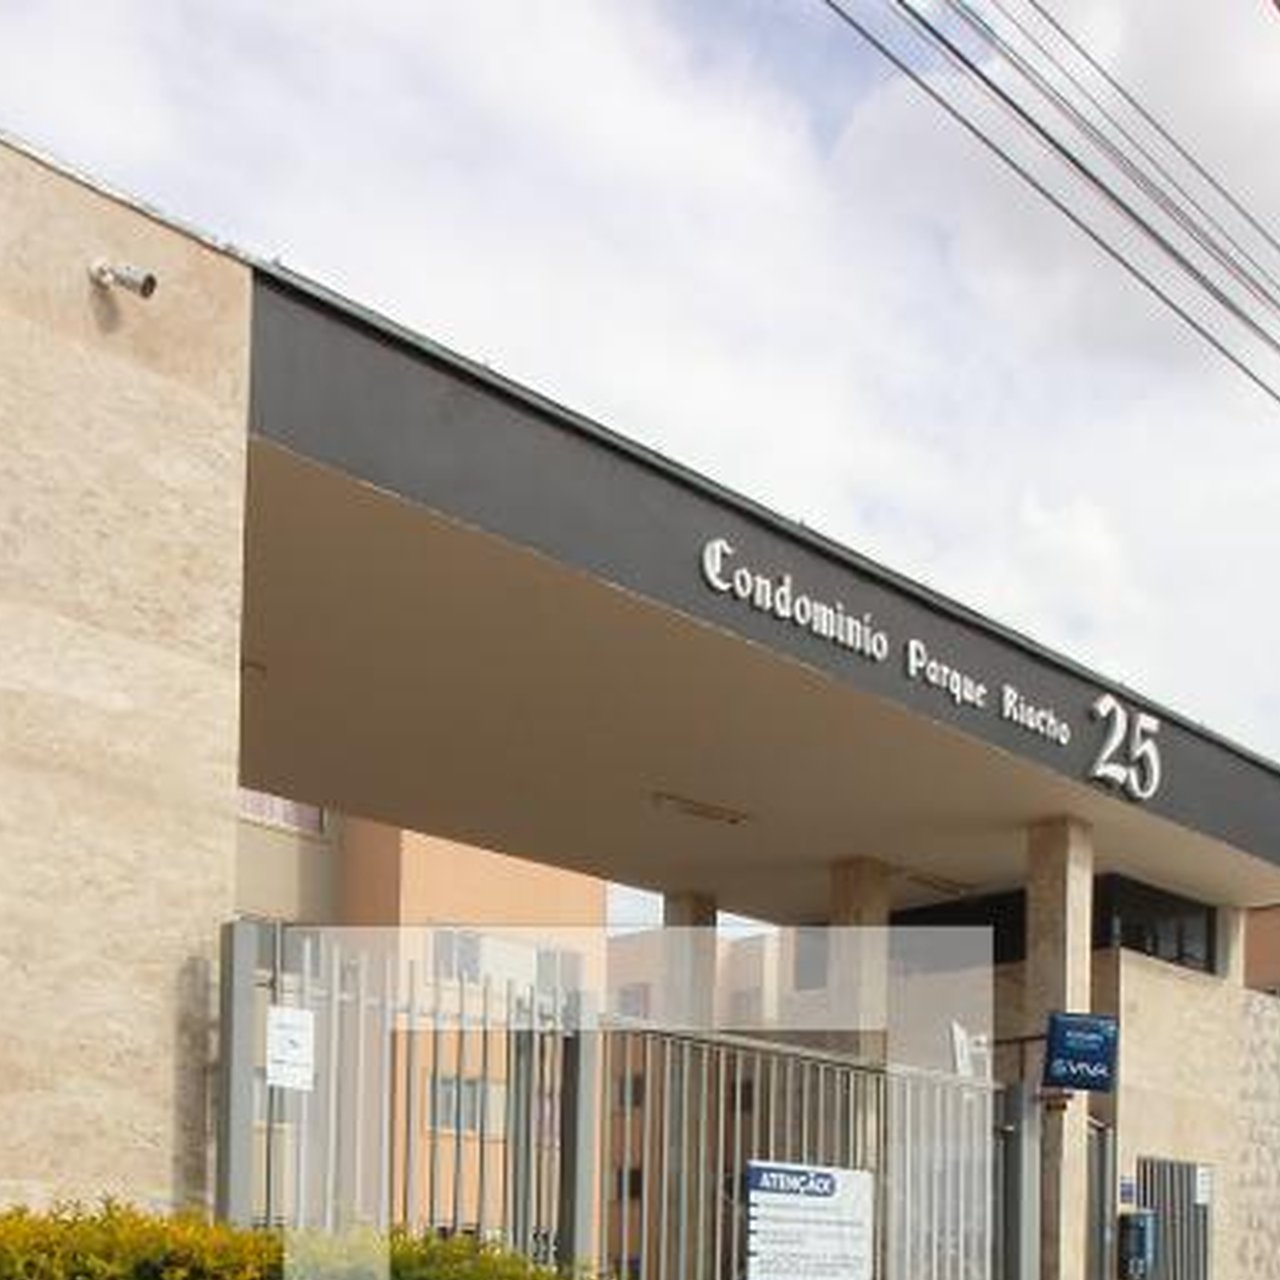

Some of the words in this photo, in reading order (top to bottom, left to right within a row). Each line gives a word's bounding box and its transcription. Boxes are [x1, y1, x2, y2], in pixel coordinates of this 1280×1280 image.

[701, 537, 889, 661] Condominio
[907, 637, 987, 708] Parque
[1001, 682, 1071, 746] Riacho
[1092, 692, 1161, 800] 25
